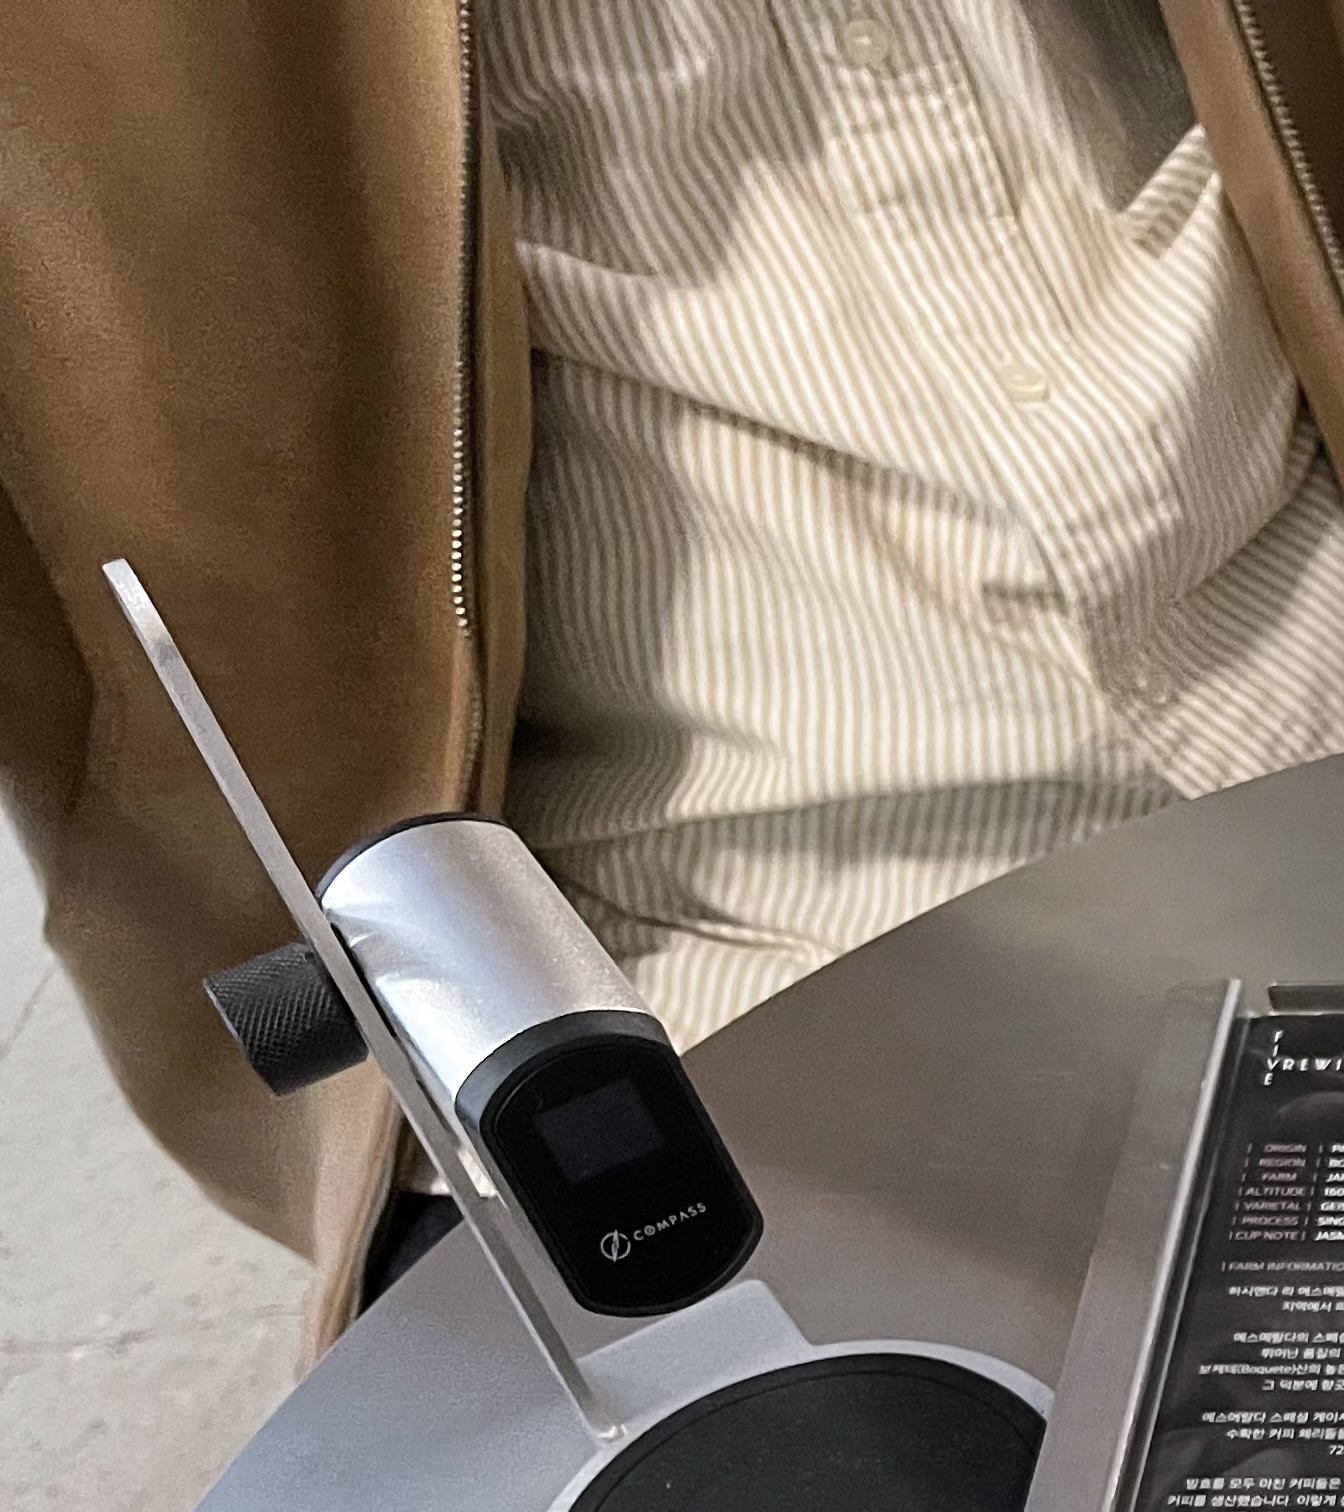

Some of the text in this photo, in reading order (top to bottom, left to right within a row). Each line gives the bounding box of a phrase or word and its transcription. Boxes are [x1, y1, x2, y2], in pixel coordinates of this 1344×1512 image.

[1261, 1172, 1297, 1182] FARM
[1245, 1187, 1305, 1197] ALTITUDE
[1243, 1201, 1301, 1211] VARIETAL
[632, 1201, 707, 1242] COMPASS
[1242, 1216, 1299, 1226] PROCESS
[1235, 1230, 1260, 1241] CUP
[1263, 1230, 1299, 1241] NOTE
[1228, 1262, 1265, 1272] FARM
